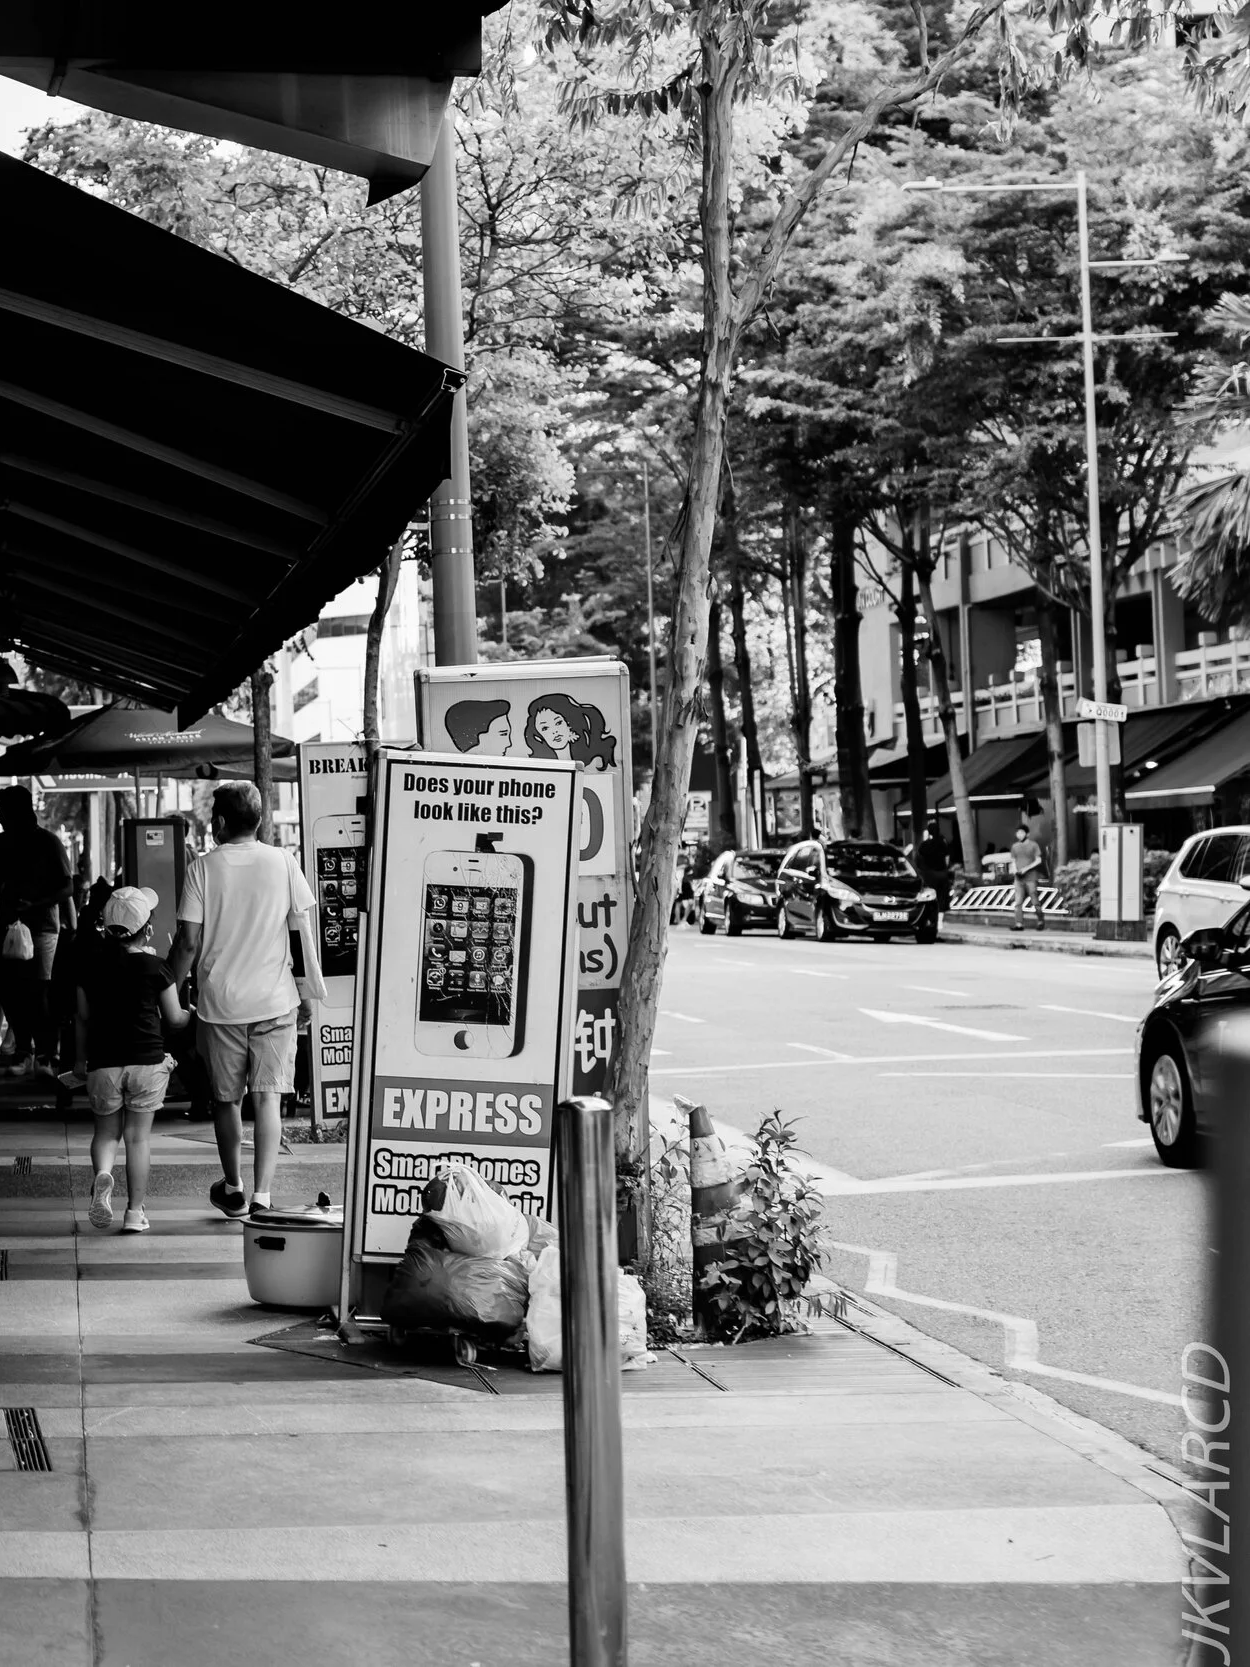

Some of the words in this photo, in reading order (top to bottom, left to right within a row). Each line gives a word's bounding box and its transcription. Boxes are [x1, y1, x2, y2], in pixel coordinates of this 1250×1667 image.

[403, 773, 449, 793] Does
[453, 778, 494, 796] your
[498, 778, 556, 798] phone
[414, 800, 453, 821] look
[457, 802, 492, 823] like
[496, 805, 543, 825] this?
[578, 893, 617, 929] ut
[321, 1025, 353, 1044] Sma
[321, 1046, 352, 1066] Mob
[325, 1086, 350, 1113] EX
[382, 1087, 543, 1136] EXPRESS
[372, 1184, 424, 1215] Mob
